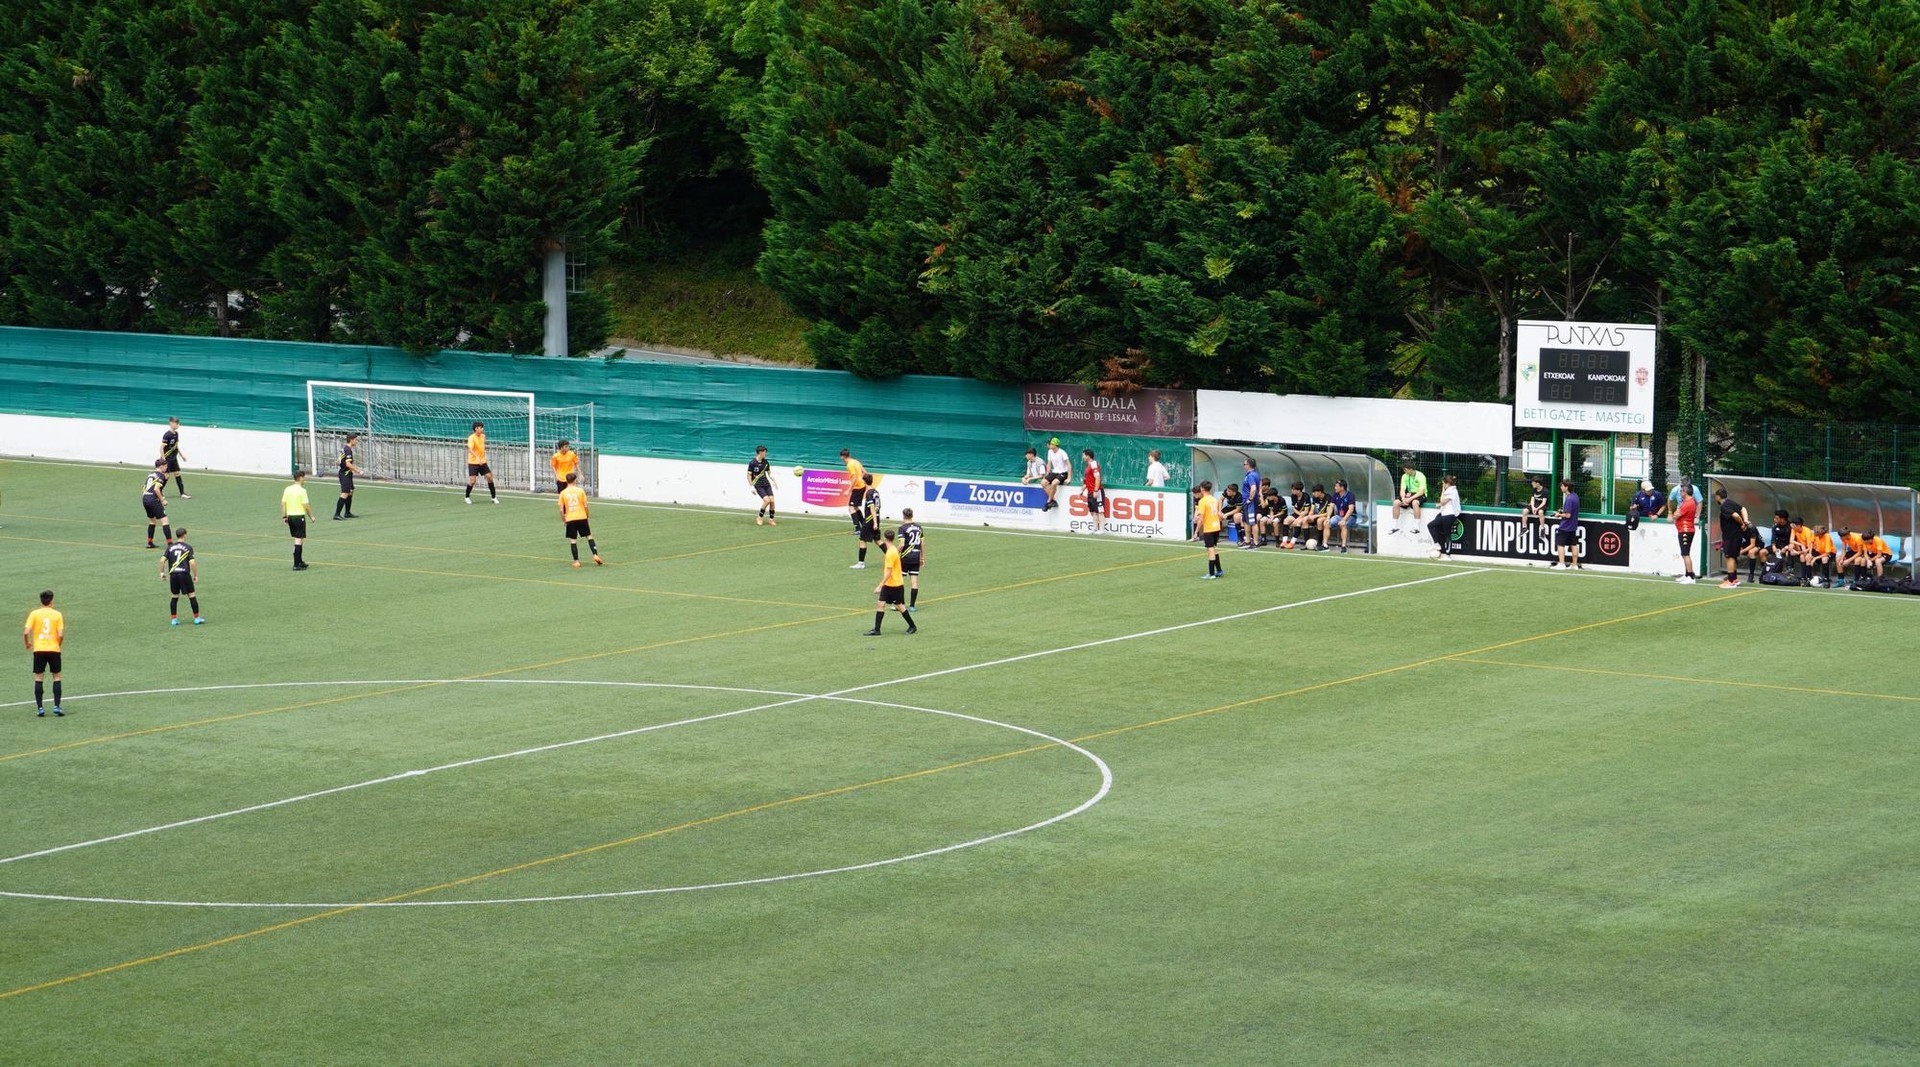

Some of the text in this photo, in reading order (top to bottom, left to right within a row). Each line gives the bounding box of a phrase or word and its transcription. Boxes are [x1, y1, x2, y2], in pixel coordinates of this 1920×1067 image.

[1547, 325, 1625, 346] PUNTXAS
[1543, 371, 1626, 382] ETXEKOAK KANPOKOAK
[1092, 396, 1137, 410] UDALA
[1028, 409, 1138, 423] AYUNTAMIENTO DE LESAKA
[1524, 408, 1547, 420] BETI
[1549, 409, 1586, 422] GAZTE
[1596, 411, 1645, 425] MASTEGI
[969, 485, 1024, 507] Zozaya
[174, 550, 182, 563] 7
